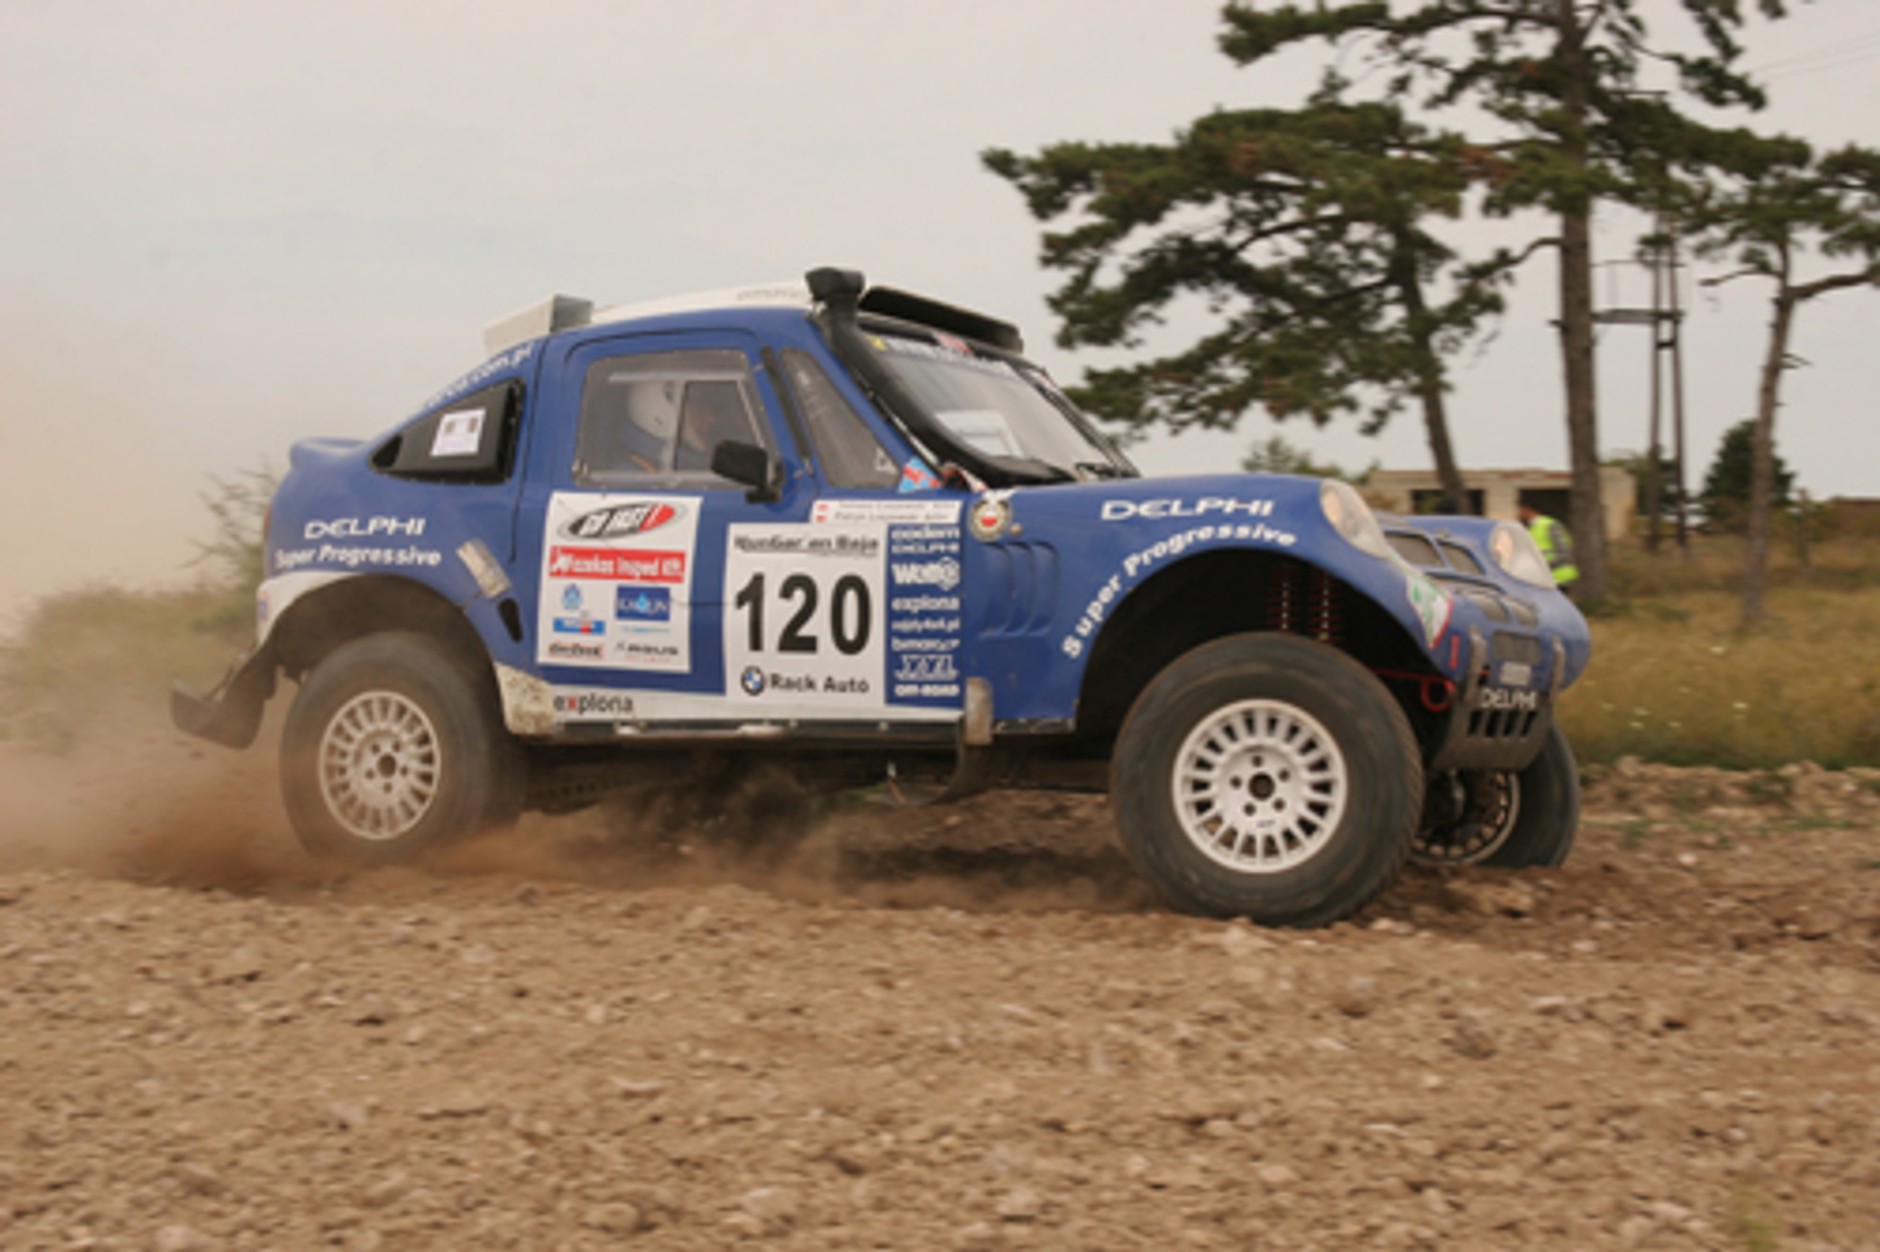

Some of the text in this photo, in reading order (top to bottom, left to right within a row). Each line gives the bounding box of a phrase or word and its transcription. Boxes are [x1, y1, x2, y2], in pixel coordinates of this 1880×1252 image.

[1101, 498, 1275, 520] DELPHI
[303, 516, 427, 539] DELPHI
[318, 544, 442, 567] Progressive
[1062, 523, 1298, 659] Super Progressive
[735, 572, 872, 656] 120
[823, 676, 870, 693] Auto
[1480, 688, 1538, 709] DELPHI
